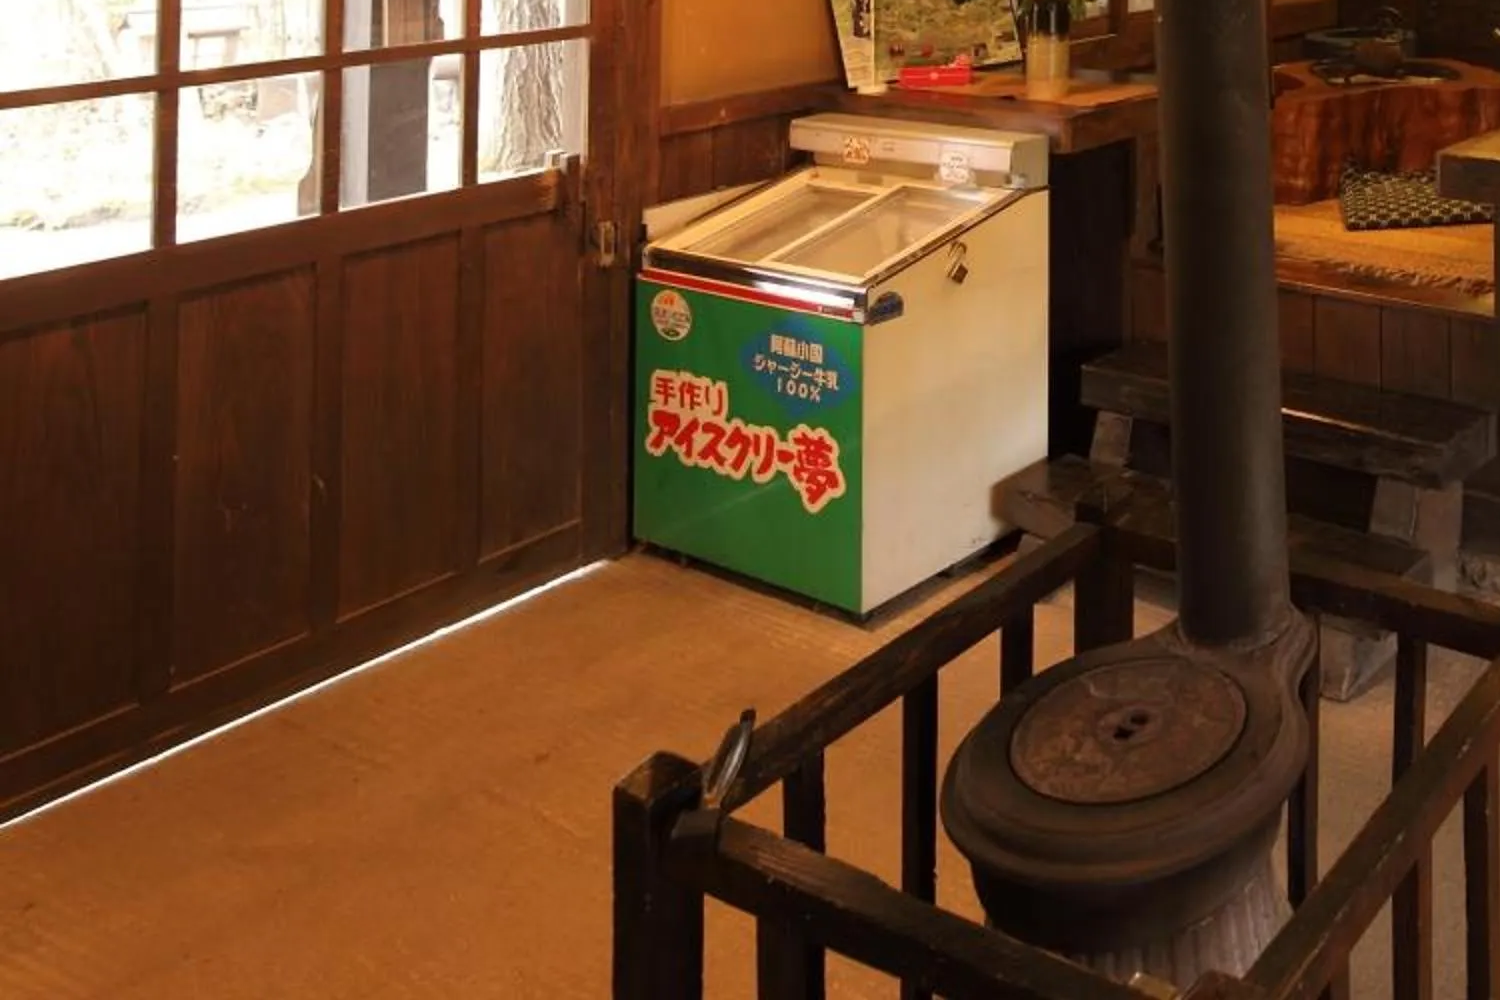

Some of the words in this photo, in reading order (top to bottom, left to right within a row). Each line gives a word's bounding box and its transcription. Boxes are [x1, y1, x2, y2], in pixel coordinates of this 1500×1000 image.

[655, 376, 723, 416] 手作り
[776, 377, 822, 403] 100%
[649, 410, 840, 505] アイスクリー夢
